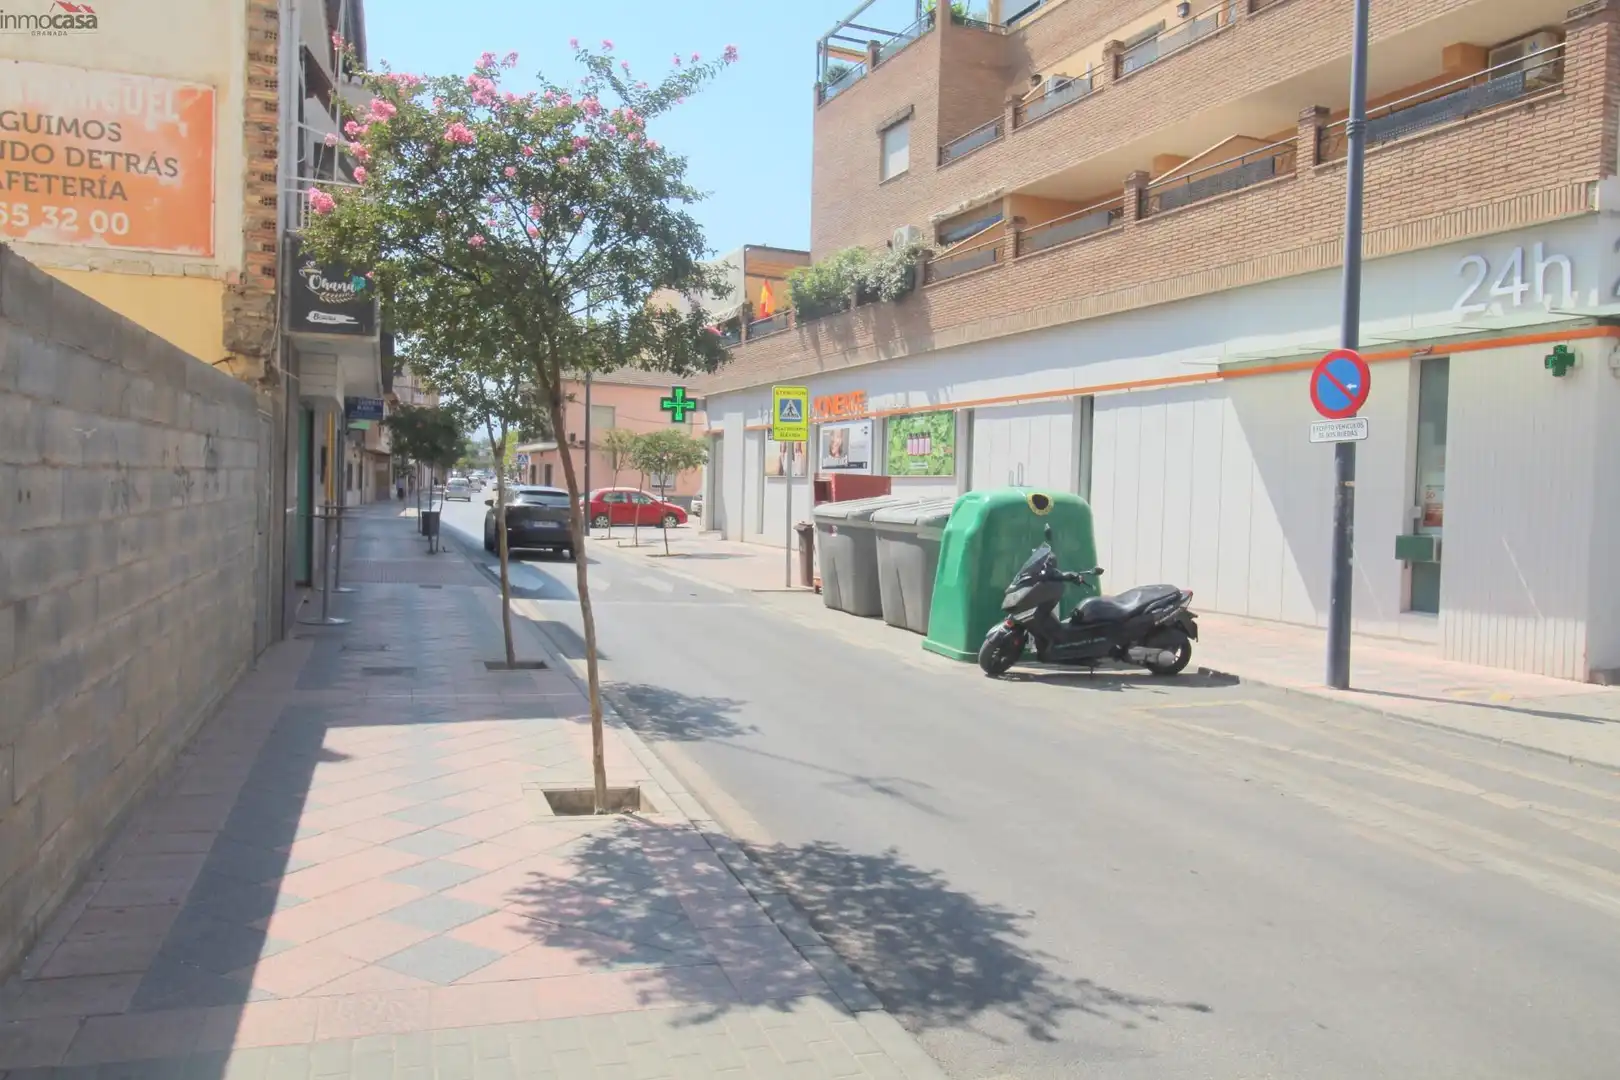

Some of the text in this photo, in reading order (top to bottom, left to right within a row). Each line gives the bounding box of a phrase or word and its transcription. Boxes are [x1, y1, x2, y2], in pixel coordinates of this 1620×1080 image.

[0, 110, 122, 142] GUIMOS
[0, 139, 179, 178] DO DETRÁS
[0, 170, 128, 201] FETERÍA
[41, 205, 79, 232] 32
[89, 209, 130, 235] 00
[309, 274, 357, 293] Ohana
[1452, 242, 1571, 310] 24h
